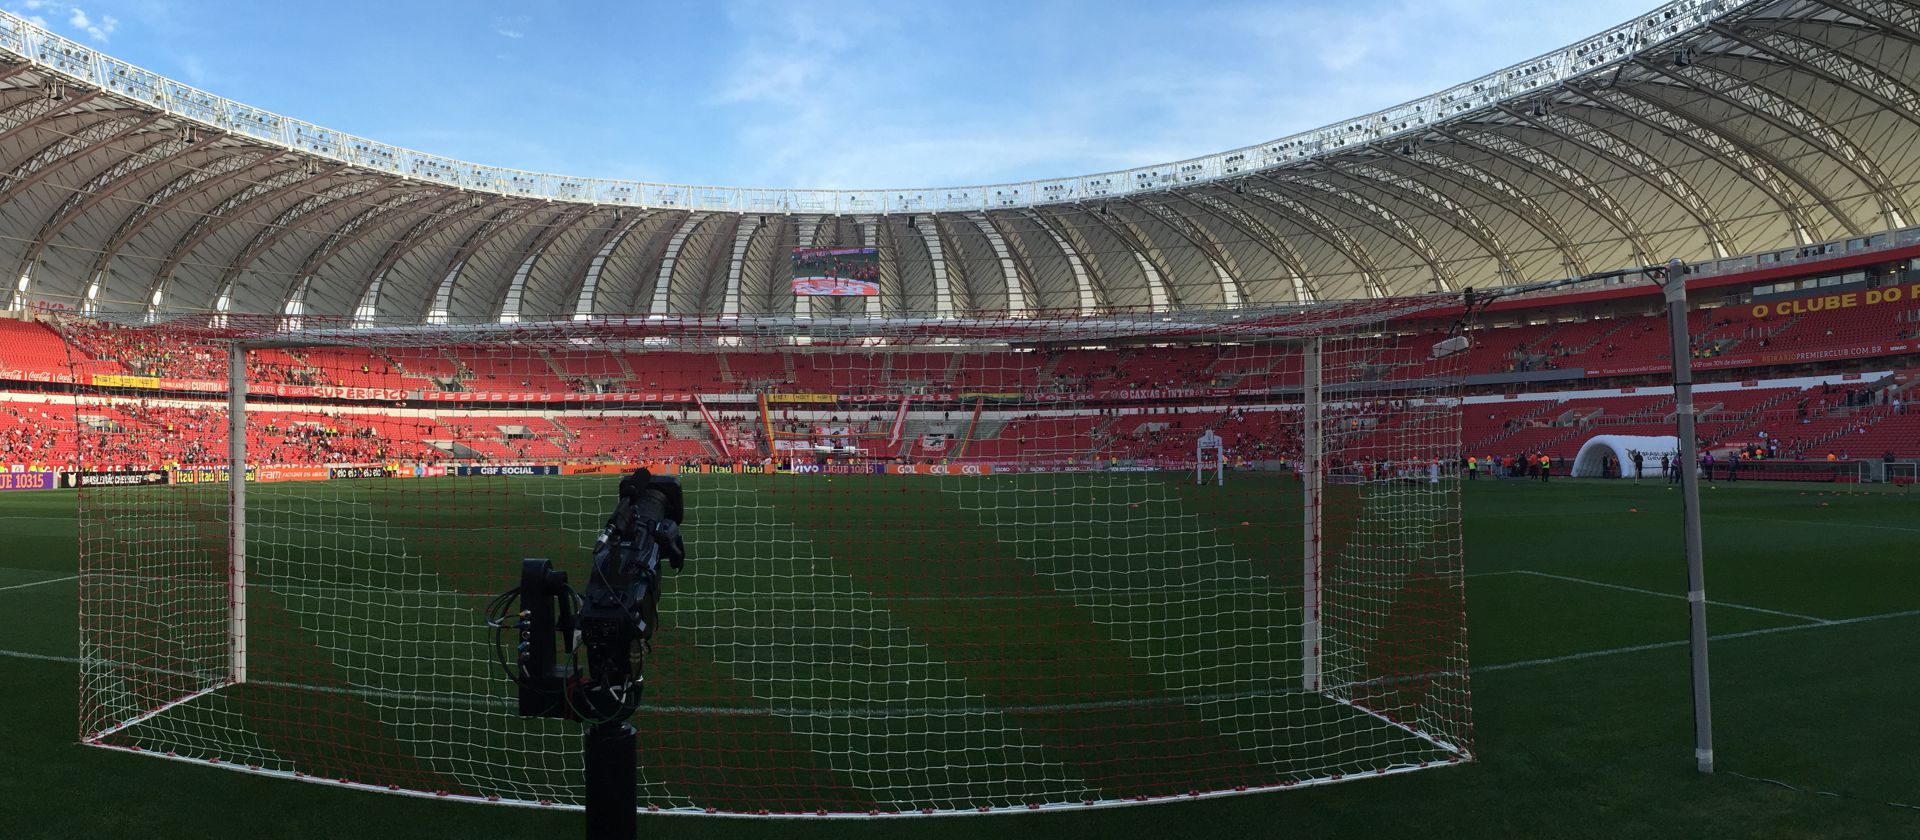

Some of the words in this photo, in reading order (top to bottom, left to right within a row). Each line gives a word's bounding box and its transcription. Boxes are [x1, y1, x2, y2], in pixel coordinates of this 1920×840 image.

[1752, 305, 1769, 318] O
[1776, 293, 1857, 315] CLUBE
[1866, 287, 1902, 305] DO
[28, 371, 51, 382] Coca-Cola
[315, 387, 365, 399] SUPER
[373, 390, 409, 400] FICO
[1130, 390, 1160, 399] CAXIAS
[1168, 389, 1194, 398] INTER
[480, 466, 499, 475] CBF
[501, 466, 534, 475] SOCIAL
[680, 464, 700, 474] Itaú
[711, 464, 732, 474] Itaú
[743, 464, 763, 474] Itaú
[823, 465, 849, 474] LIGUE
[897, 465, 918, 474] GOL
[929, 465, 950, 474] GOL
[962, 465, 982, 474] GOL
[15, 473, 44, 489] 10315
[176, 470, 193, 483] Itaú
[198, 470, 215, 482] Itaú
